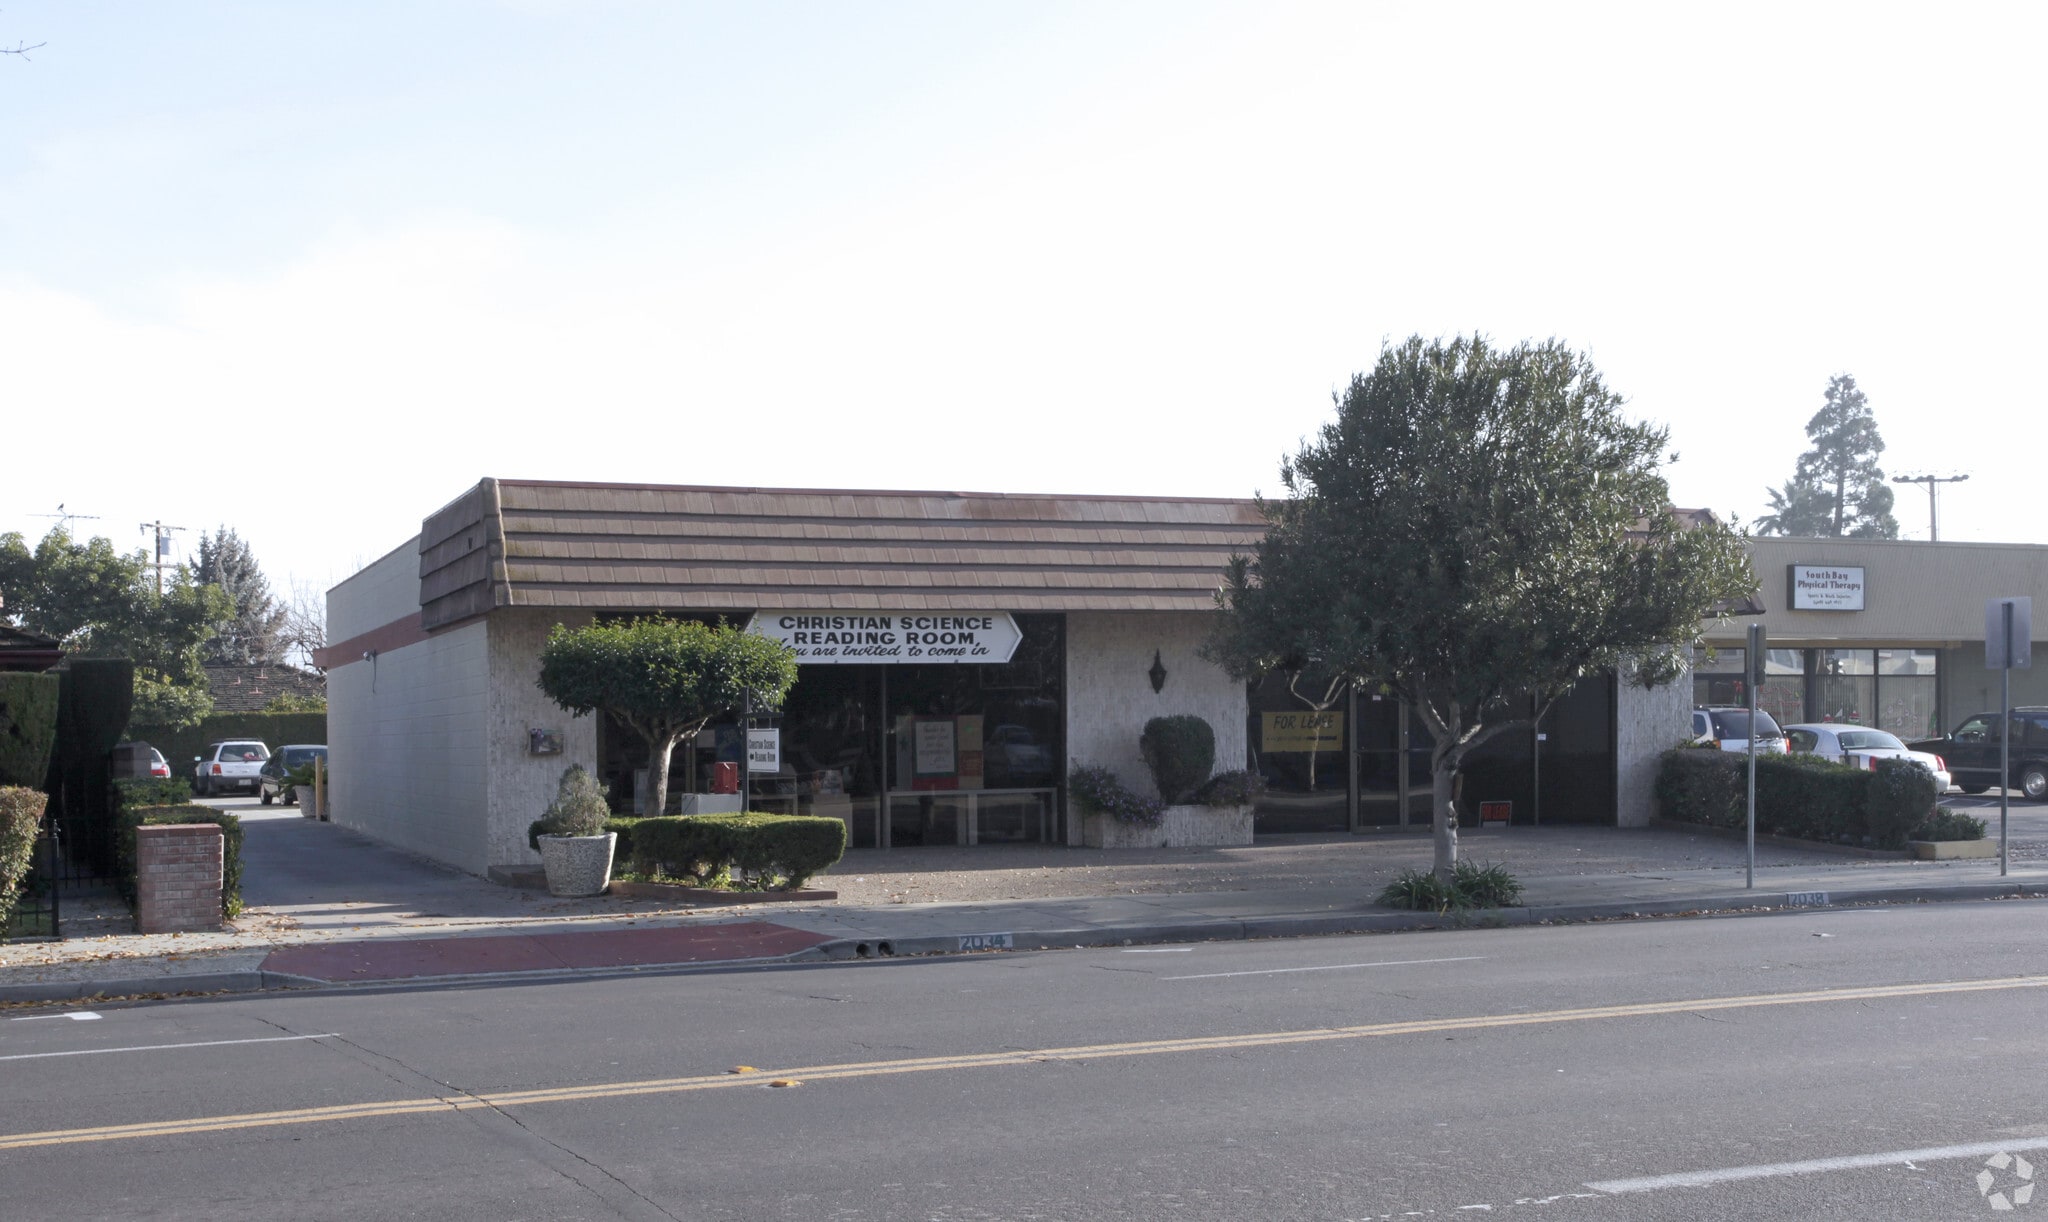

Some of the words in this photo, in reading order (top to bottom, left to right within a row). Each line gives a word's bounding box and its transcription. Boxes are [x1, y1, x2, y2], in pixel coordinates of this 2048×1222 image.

[1806, 570, 1831, 579] South
[1832, 570, 1849, 581] Bay
[1797, 579, 1828, 590] Physical
[1830, 580, 1861, 591] Therapy
[779, 616, 892, 630] CHRISTIAN
[900, 616, 993, 630] SCIENCE
[794, 632, 896, 645] READING
[906, 632, 974, 645] ROOM
[812, 646, 838, 656] are
[842, 645, 902, 656] invited
[907, 645, 923, 657] to
[928, 646, 967, 656] come
[971, 642, 991, 656] in
[1272, 715, 1297, 729] FOR
[1300, 714, 1335, 729] LEASE
[1791, 892, 1825, 905] 2038
[960, 934, 1005, 950] 2034
